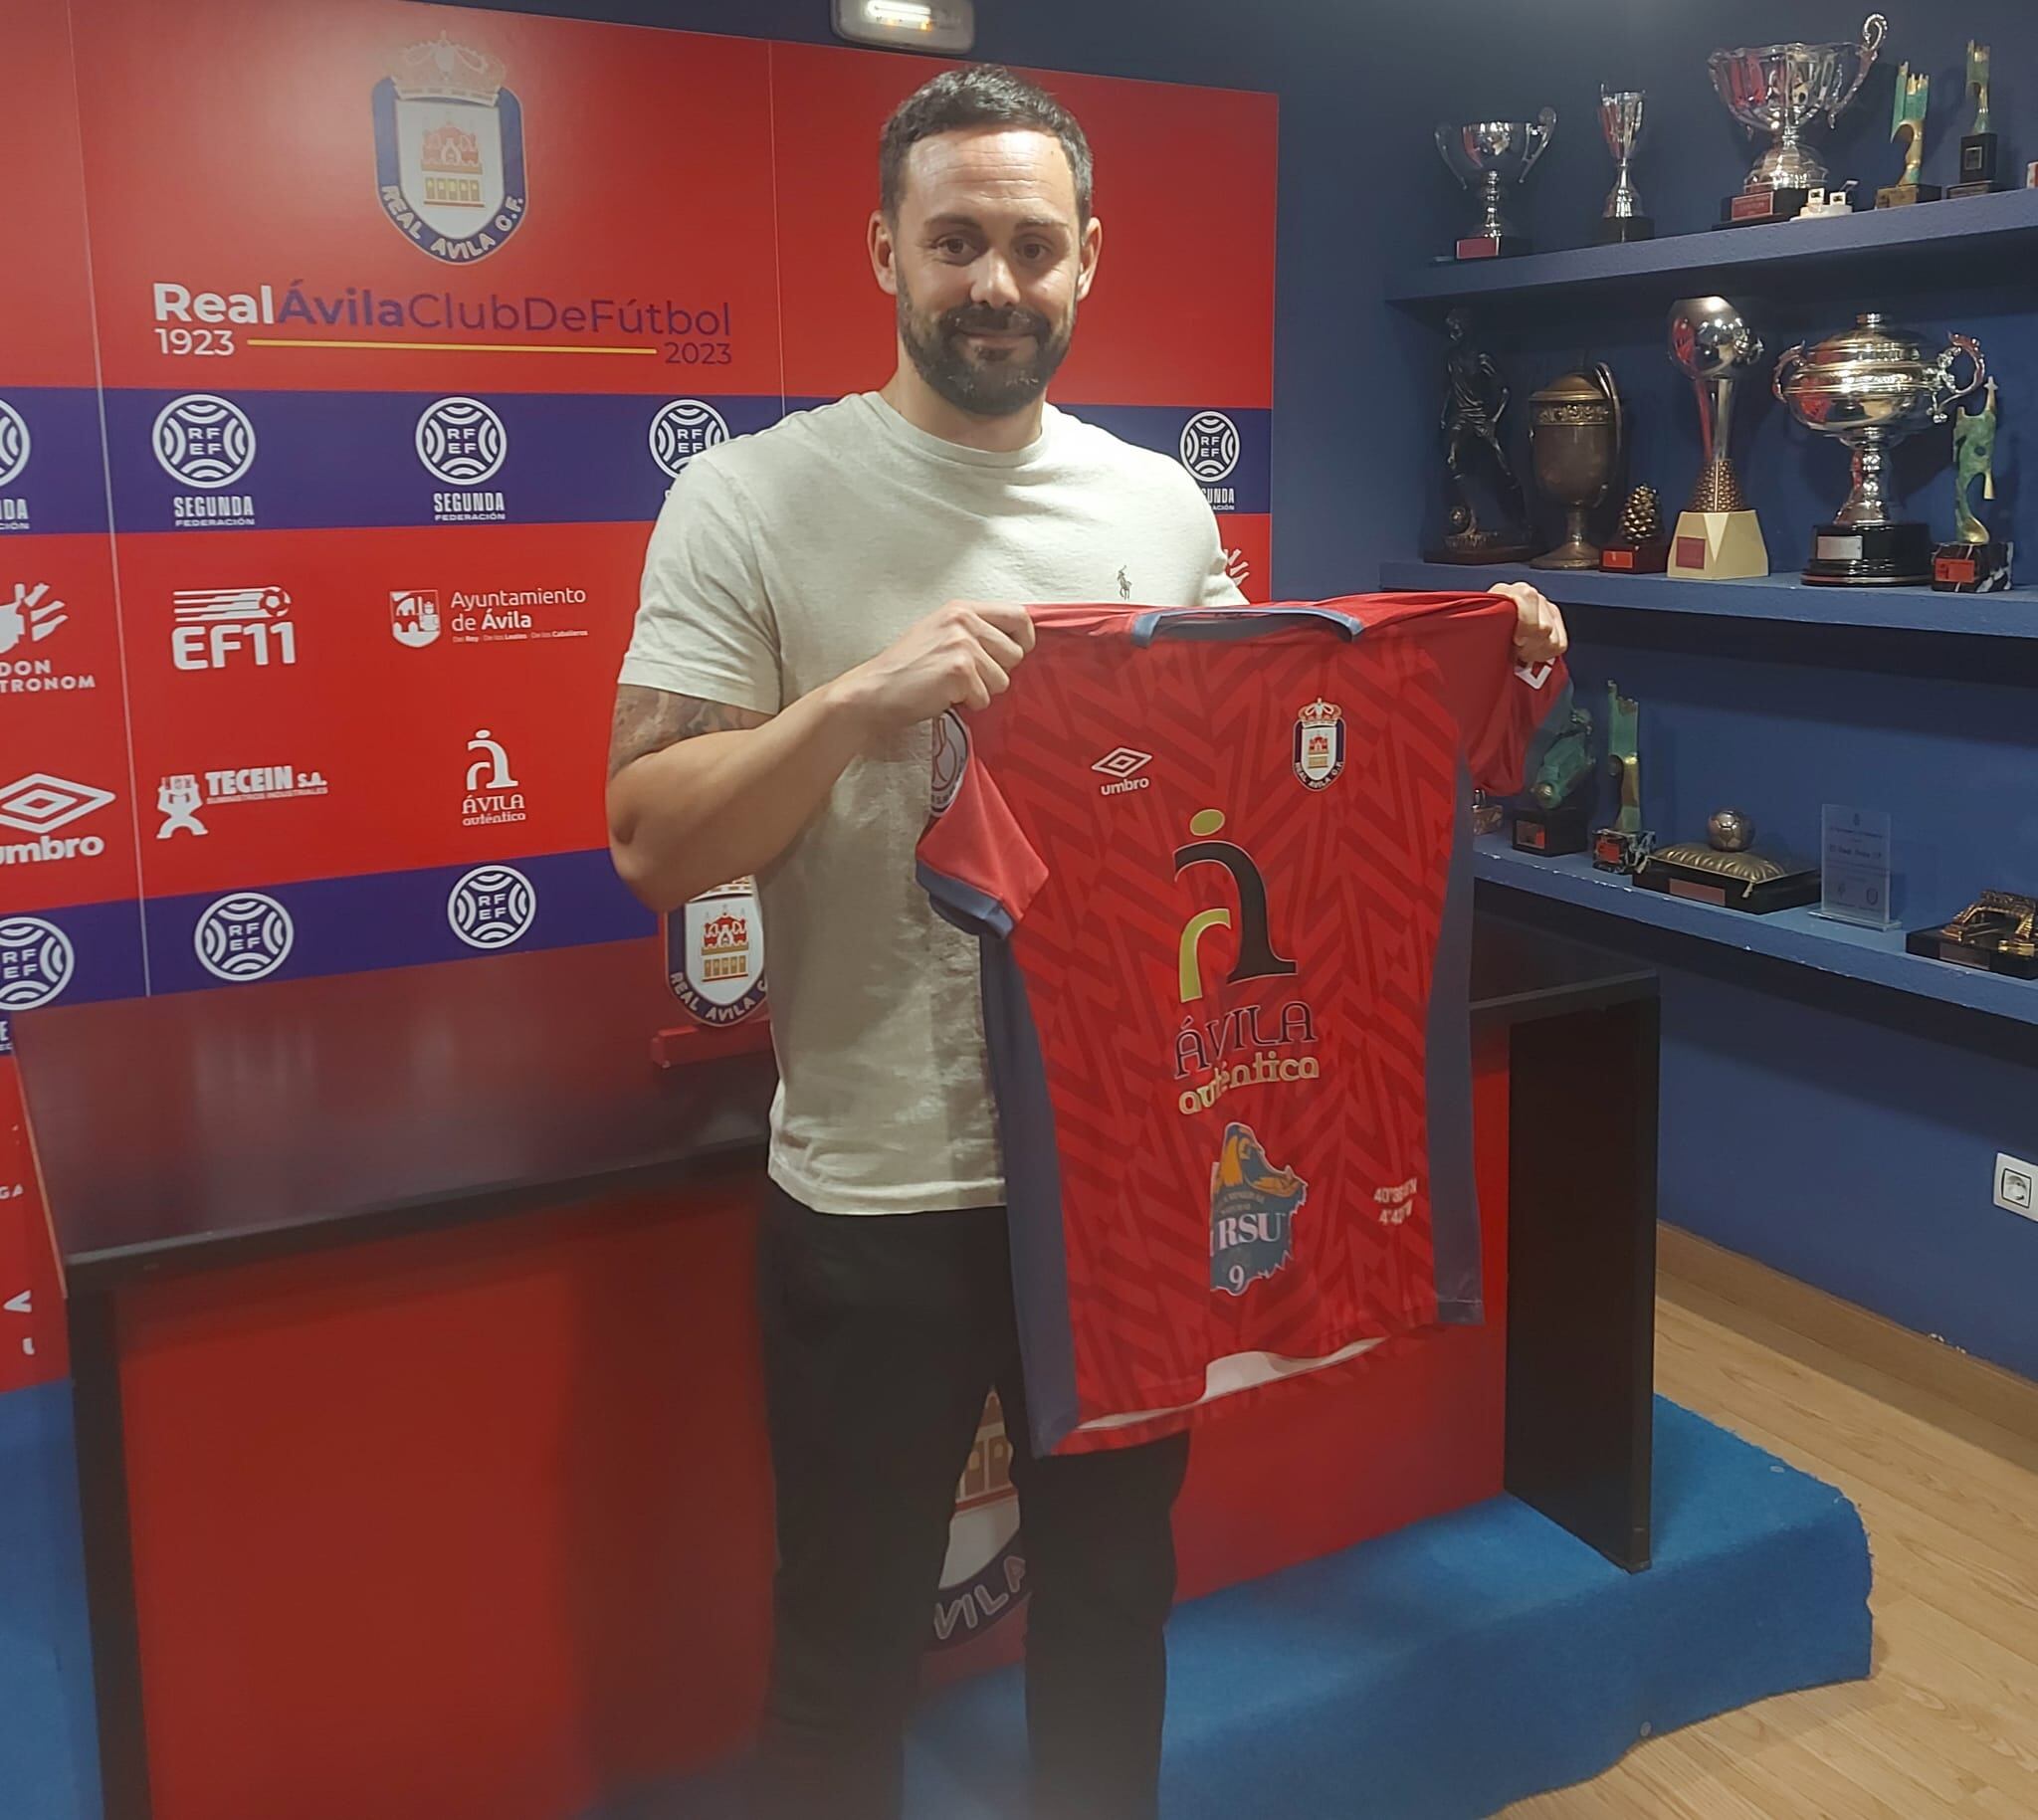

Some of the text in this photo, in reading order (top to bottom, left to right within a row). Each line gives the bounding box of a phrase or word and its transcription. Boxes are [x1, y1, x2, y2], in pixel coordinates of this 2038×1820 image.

[382, 185, 422, 240] REAL
[154, 328, 235, 356] 1923
[665, 342, 732, 365] 2023
[173, 496, 255, 517] SEGUNDA
[434, 492, 506, 512] SEGUNDA
[175, 517, 256, 527] FEDERACIÓN
[434, 512, 507, 521] FEDERACIÓN
[451, 587, 587, 612] Ayuntamiento
[451, 608, 532, 632] de Ávila
[171, 621, 297, 671] EF11
[205, 764, 294, 796] TECEIN
[1101, 777, 1150, 796] umbro
[462, 794, 525, 814] ÁVILA
[670, 971, 701, 1011] REAL
[705, 997, 756, 1022] AVILA
[1173, 1001, 1319, 1080] ÁVILA
[1218, 1212, 1282, 1251] RSU
[1228, 1265, 1245, 1292] 9
[933, 1555, 1027, 1640] VILA
